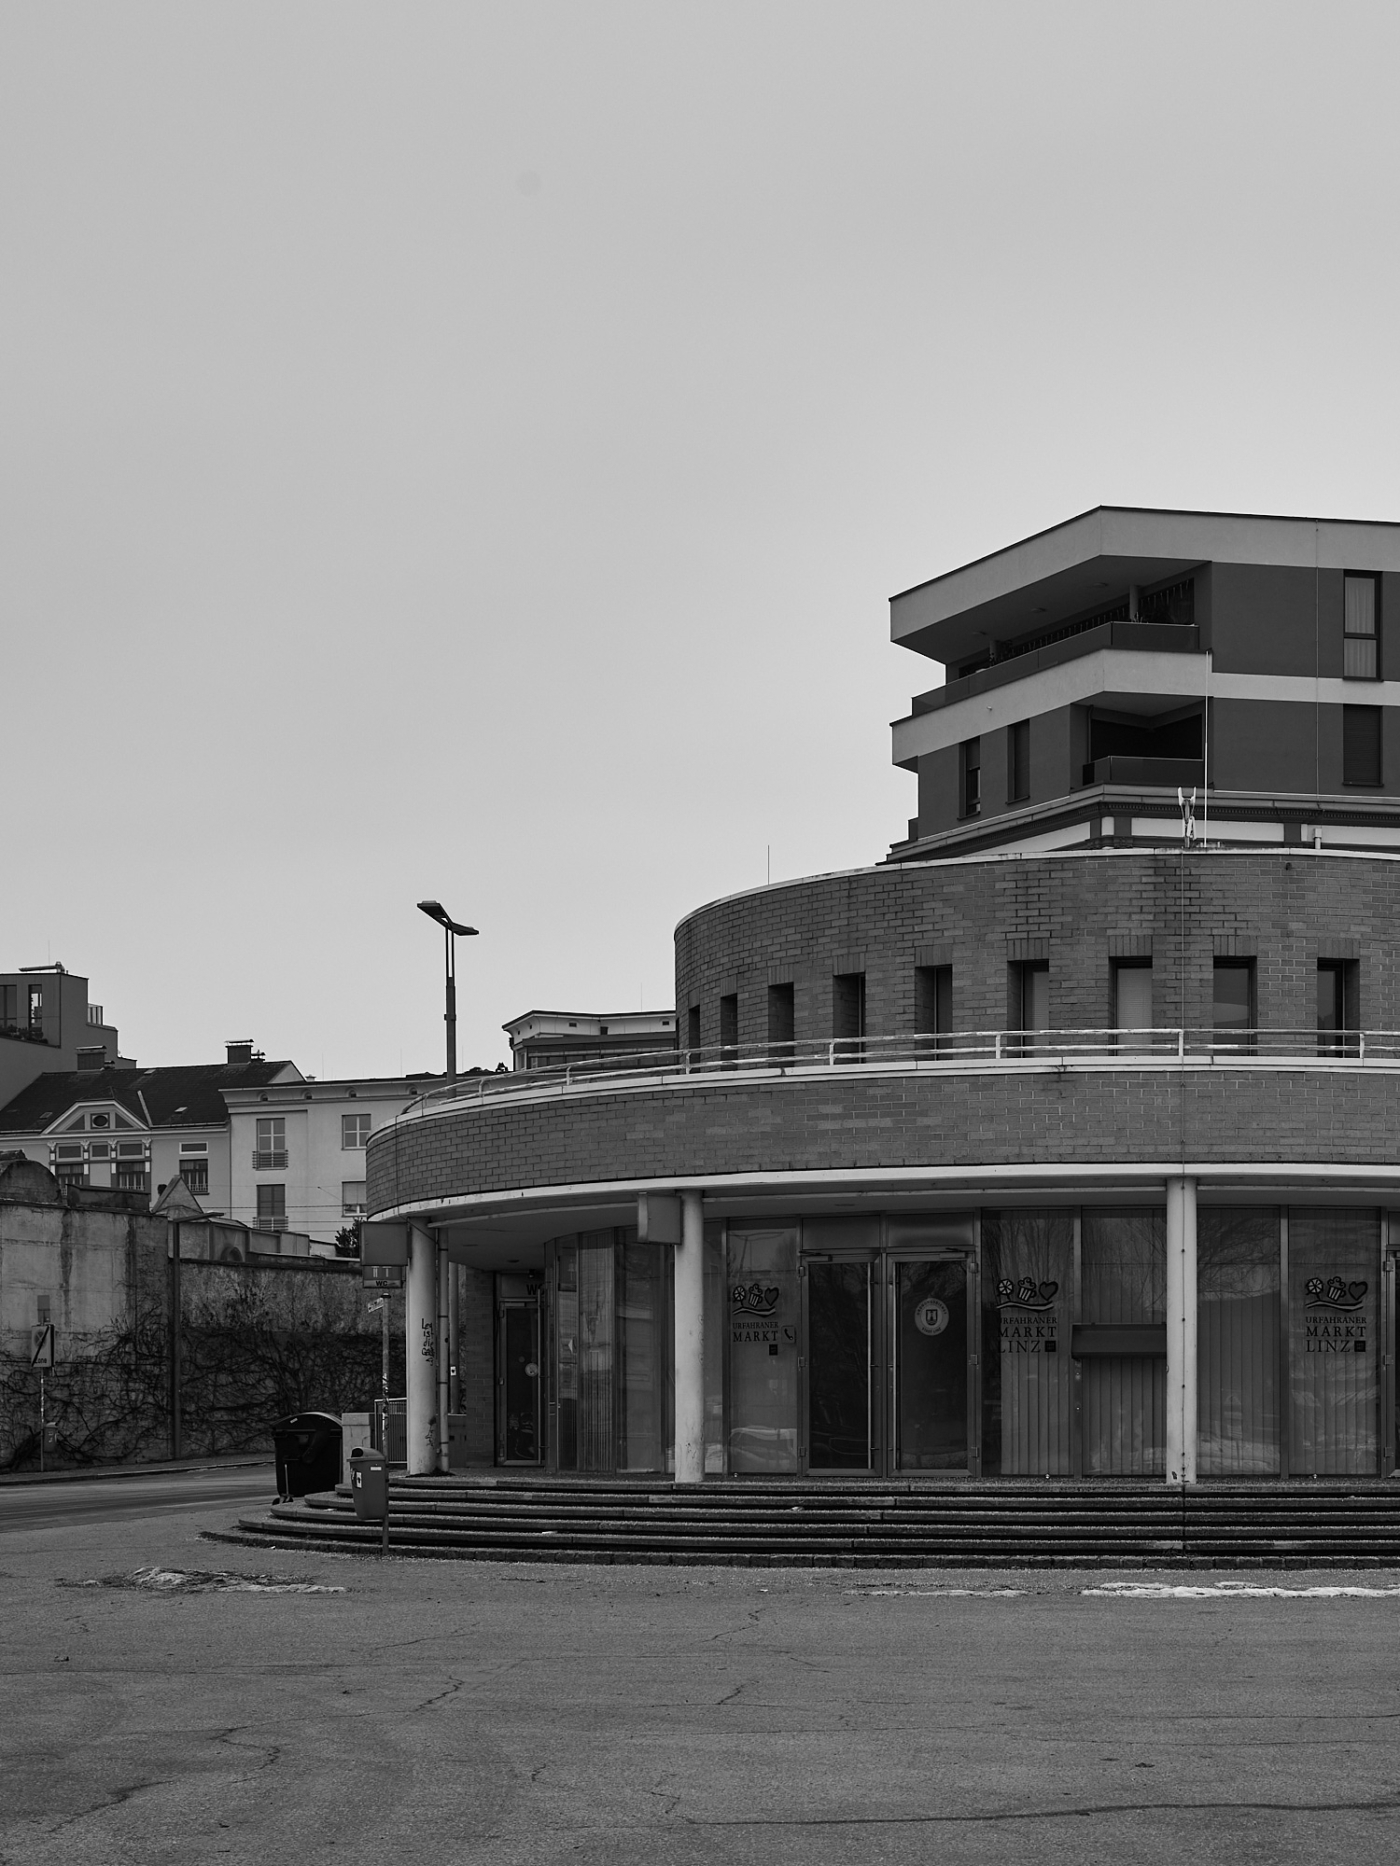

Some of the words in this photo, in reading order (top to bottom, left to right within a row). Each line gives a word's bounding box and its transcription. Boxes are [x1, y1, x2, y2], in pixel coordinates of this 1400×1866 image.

[1305, 1316, 1367, 1324] URFAHRANER
[733, 1330, 778, 1342] MARKT
[997, 1326, 1056, 1337] MARKT
[1306, 1326, 1366, 1337] MARKT
[997, 1340, 1041, 1353] LINZ
[1306, 1340, 1350, 1352] LINZ
